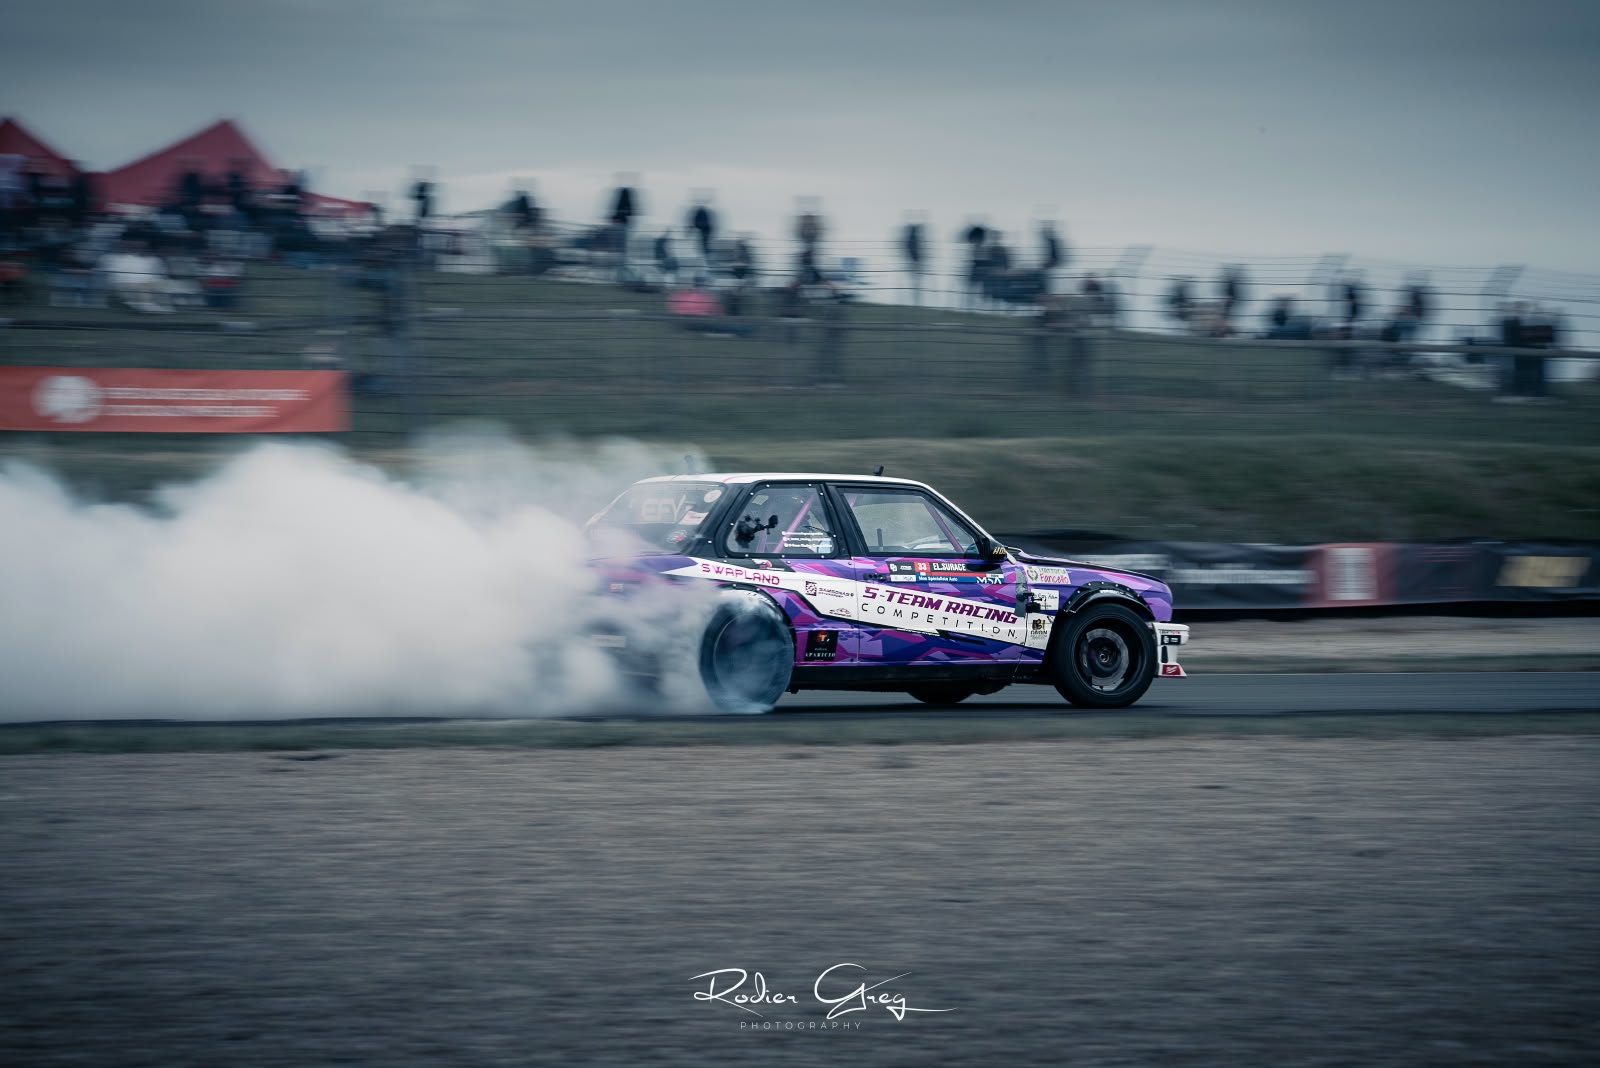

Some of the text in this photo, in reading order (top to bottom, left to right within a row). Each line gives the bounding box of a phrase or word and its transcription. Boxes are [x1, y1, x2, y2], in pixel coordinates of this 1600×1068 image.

[701, 563, 780, 586] SWAPLAND
[917, 562, 927, 571] 33
[862, 586, 943, 610] S-TEAM
[945, 600, 1018, 624] RACING
[861, 603, 1016, 637] COMPETITION
